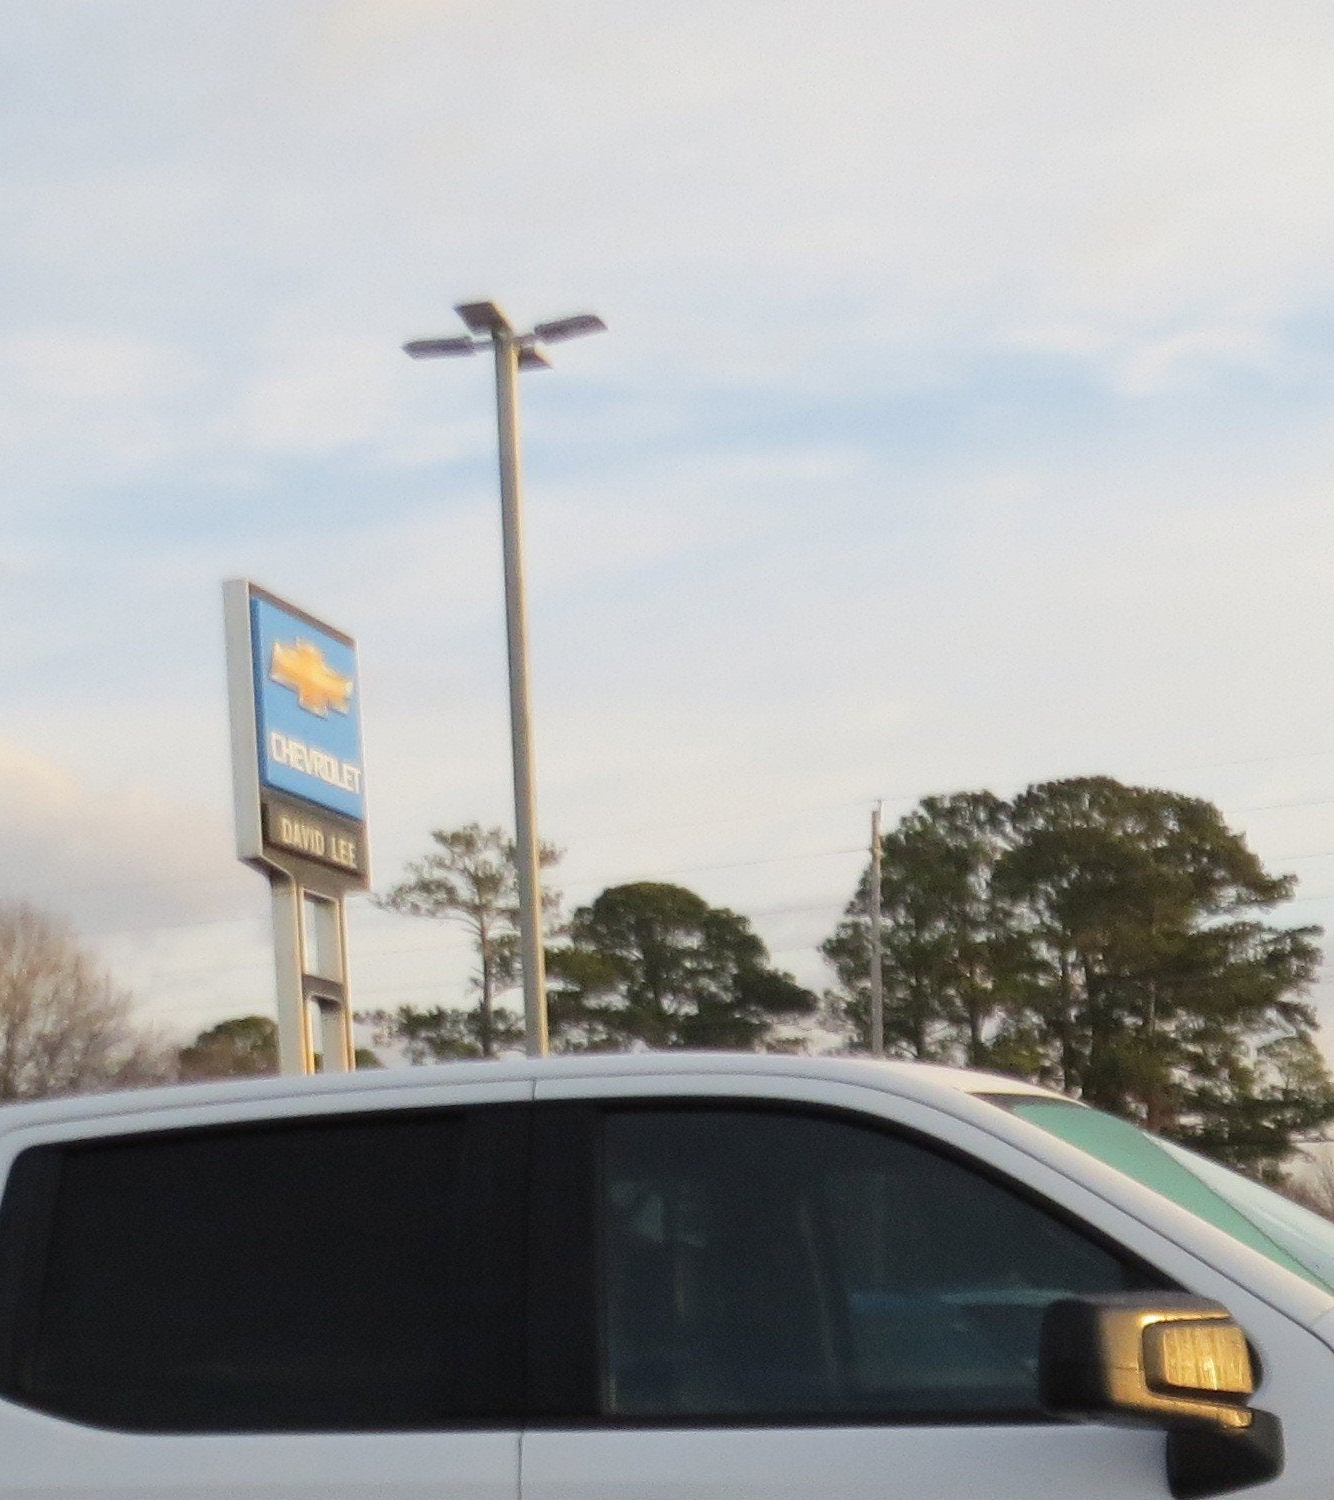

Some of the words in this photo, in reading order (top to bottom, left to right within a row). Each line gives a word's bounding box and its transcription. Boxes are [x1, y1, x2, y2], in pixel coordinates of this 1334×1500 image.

[270, 731, 362, 794] CHEVROLET
[281, 816, 326, 857] DAVID
[331, 835, 358, 870] LEE
